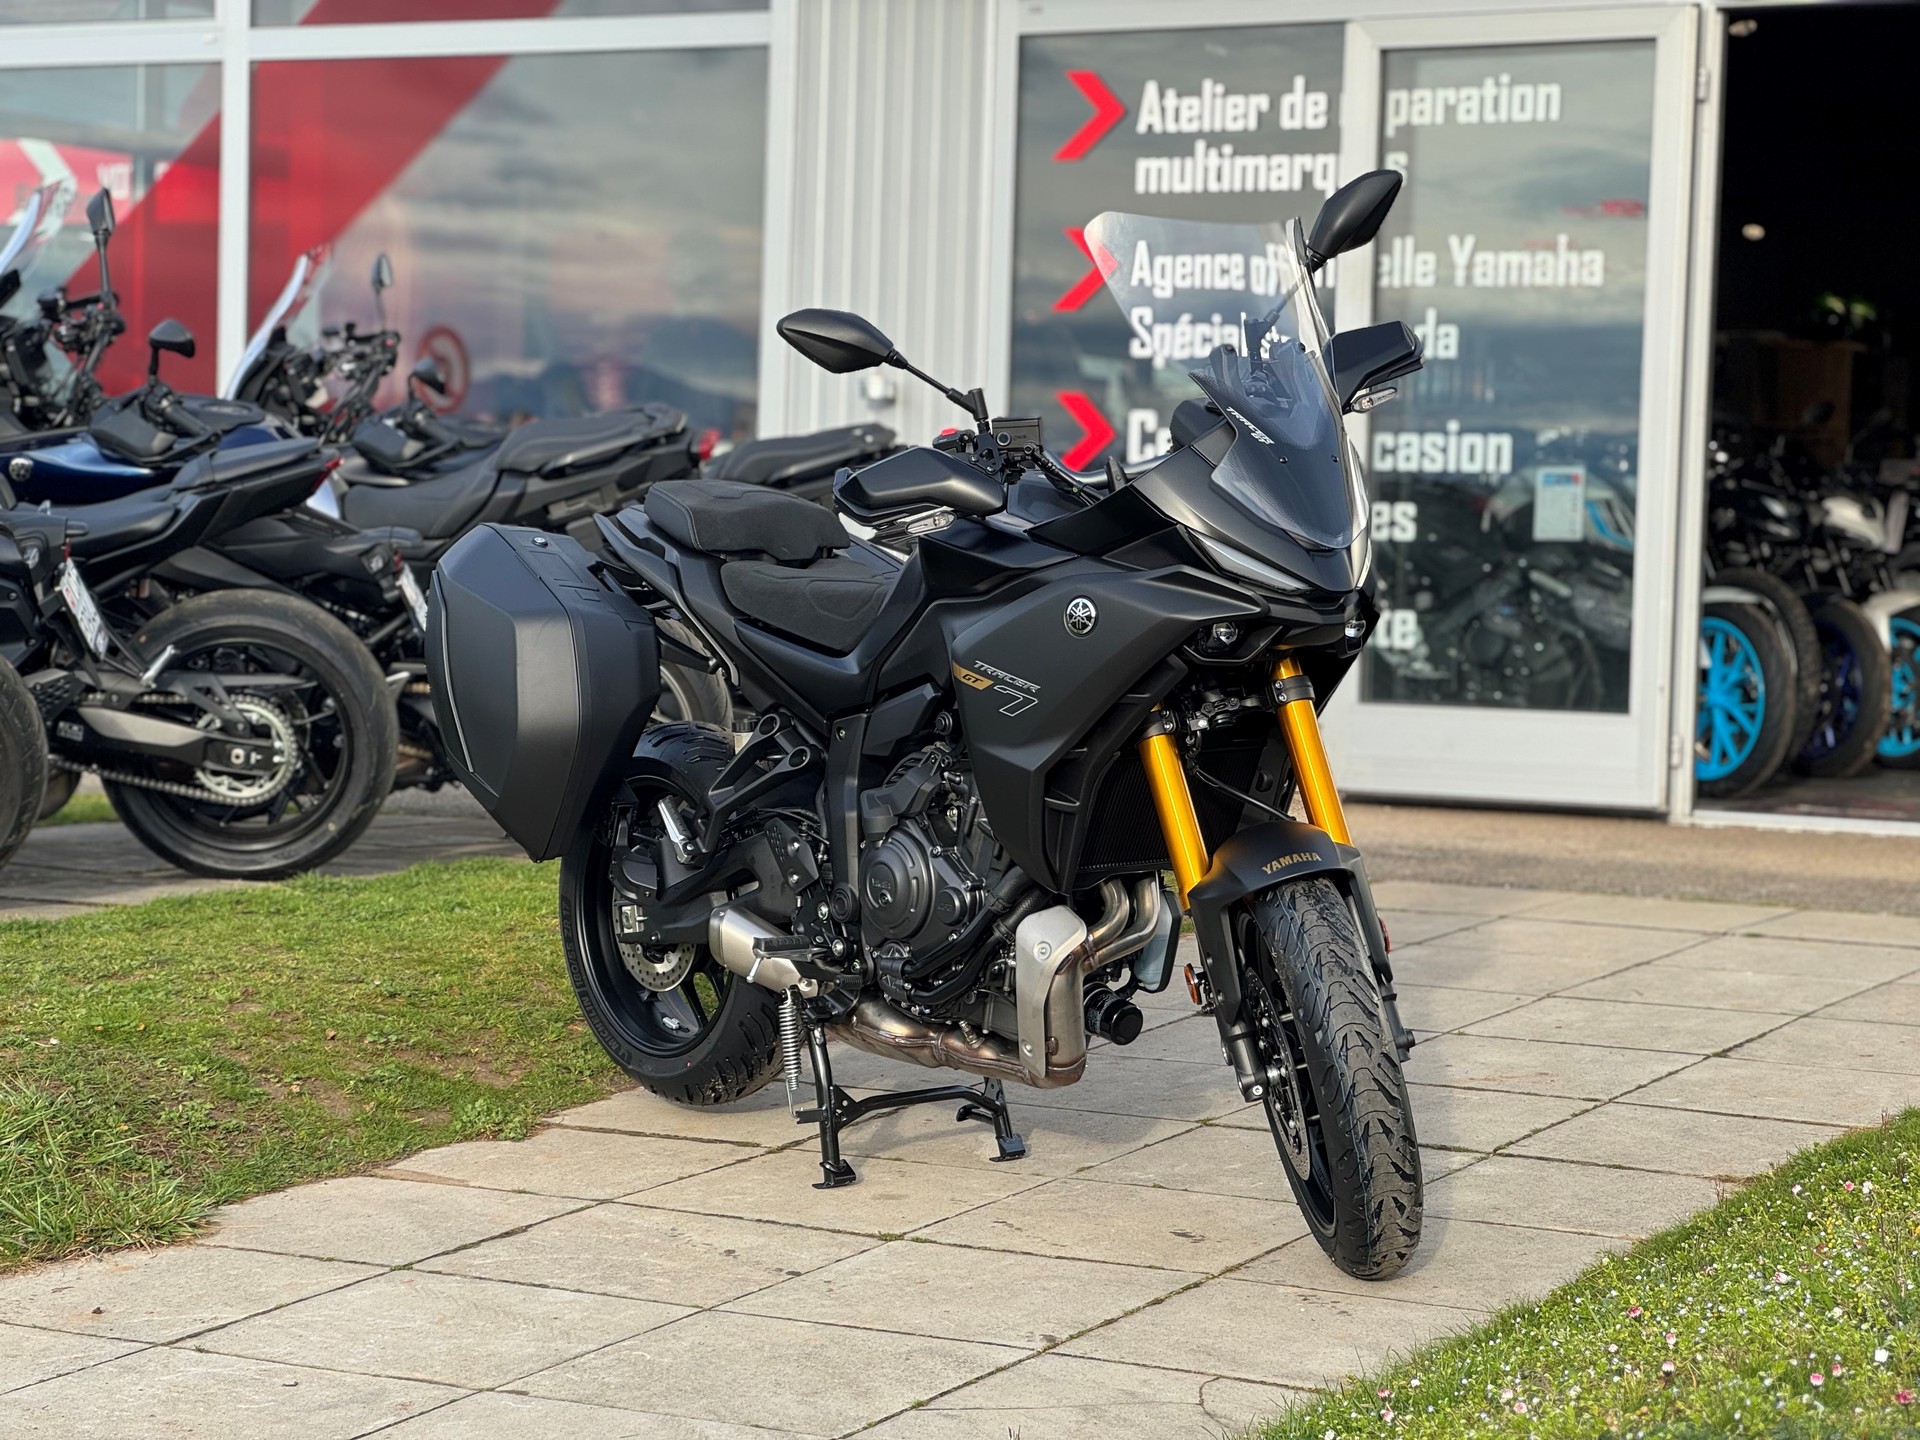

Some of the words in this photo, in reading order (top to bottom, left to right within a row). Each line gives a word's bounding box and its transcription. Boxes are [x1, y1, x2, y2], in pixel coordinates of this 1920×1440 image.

[1136, 78, 1270, 134] Atelier
[1279, 75, 1328, 130] de
[1339, 73, 1562, 138] paration
[1135, 138, 1408, 202] multimarqs
[1130, 240, 1245, 298] Agence
[1448, 233, 1605, 287] Yamaha
[1372, 419, 1513, 474] casion
[962, 673, 984, 684] GT
[973, 660, 1041, 693] TRACER
[993, 685, 1039, 717] 7
[1262, 852, 1322, 875] YAMAHA
